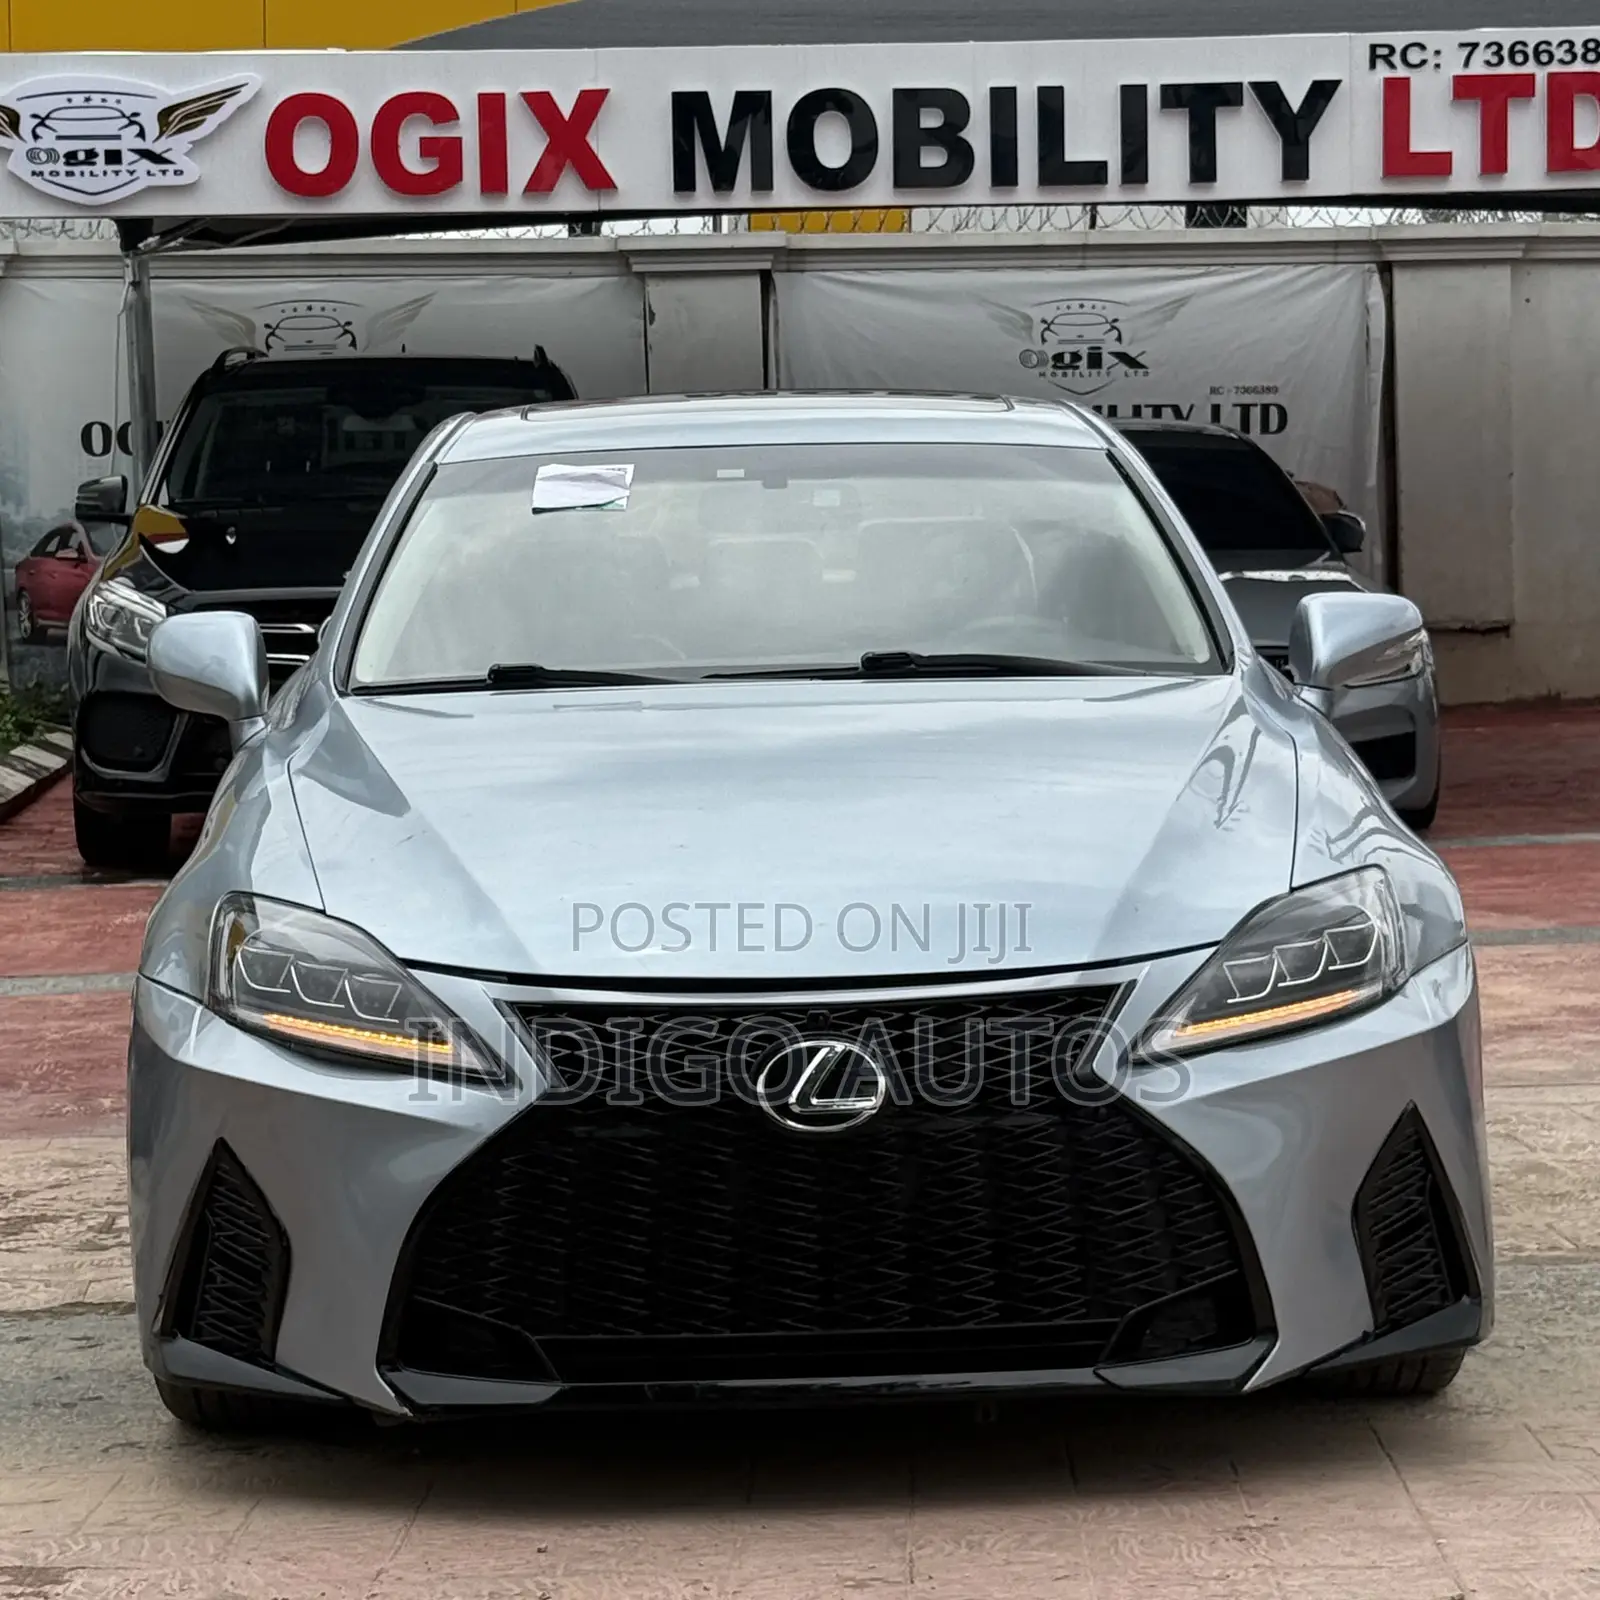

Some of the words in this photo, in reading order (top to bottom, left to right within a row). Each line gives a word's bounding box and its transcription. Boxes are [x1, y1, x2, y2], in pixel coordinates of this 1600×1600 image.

[1369, 42, 1442, 70] RC:
[1458, 38, 1600, 68] 736638
[265, 88, 618, 197] OGIX
[670, 79, 1342, 193] MOBILITY
[1382, 71, 1600, 176] LTD
[31, 169, 136, 177] MOBILITY
[146, 169, 184, 177] LTD
